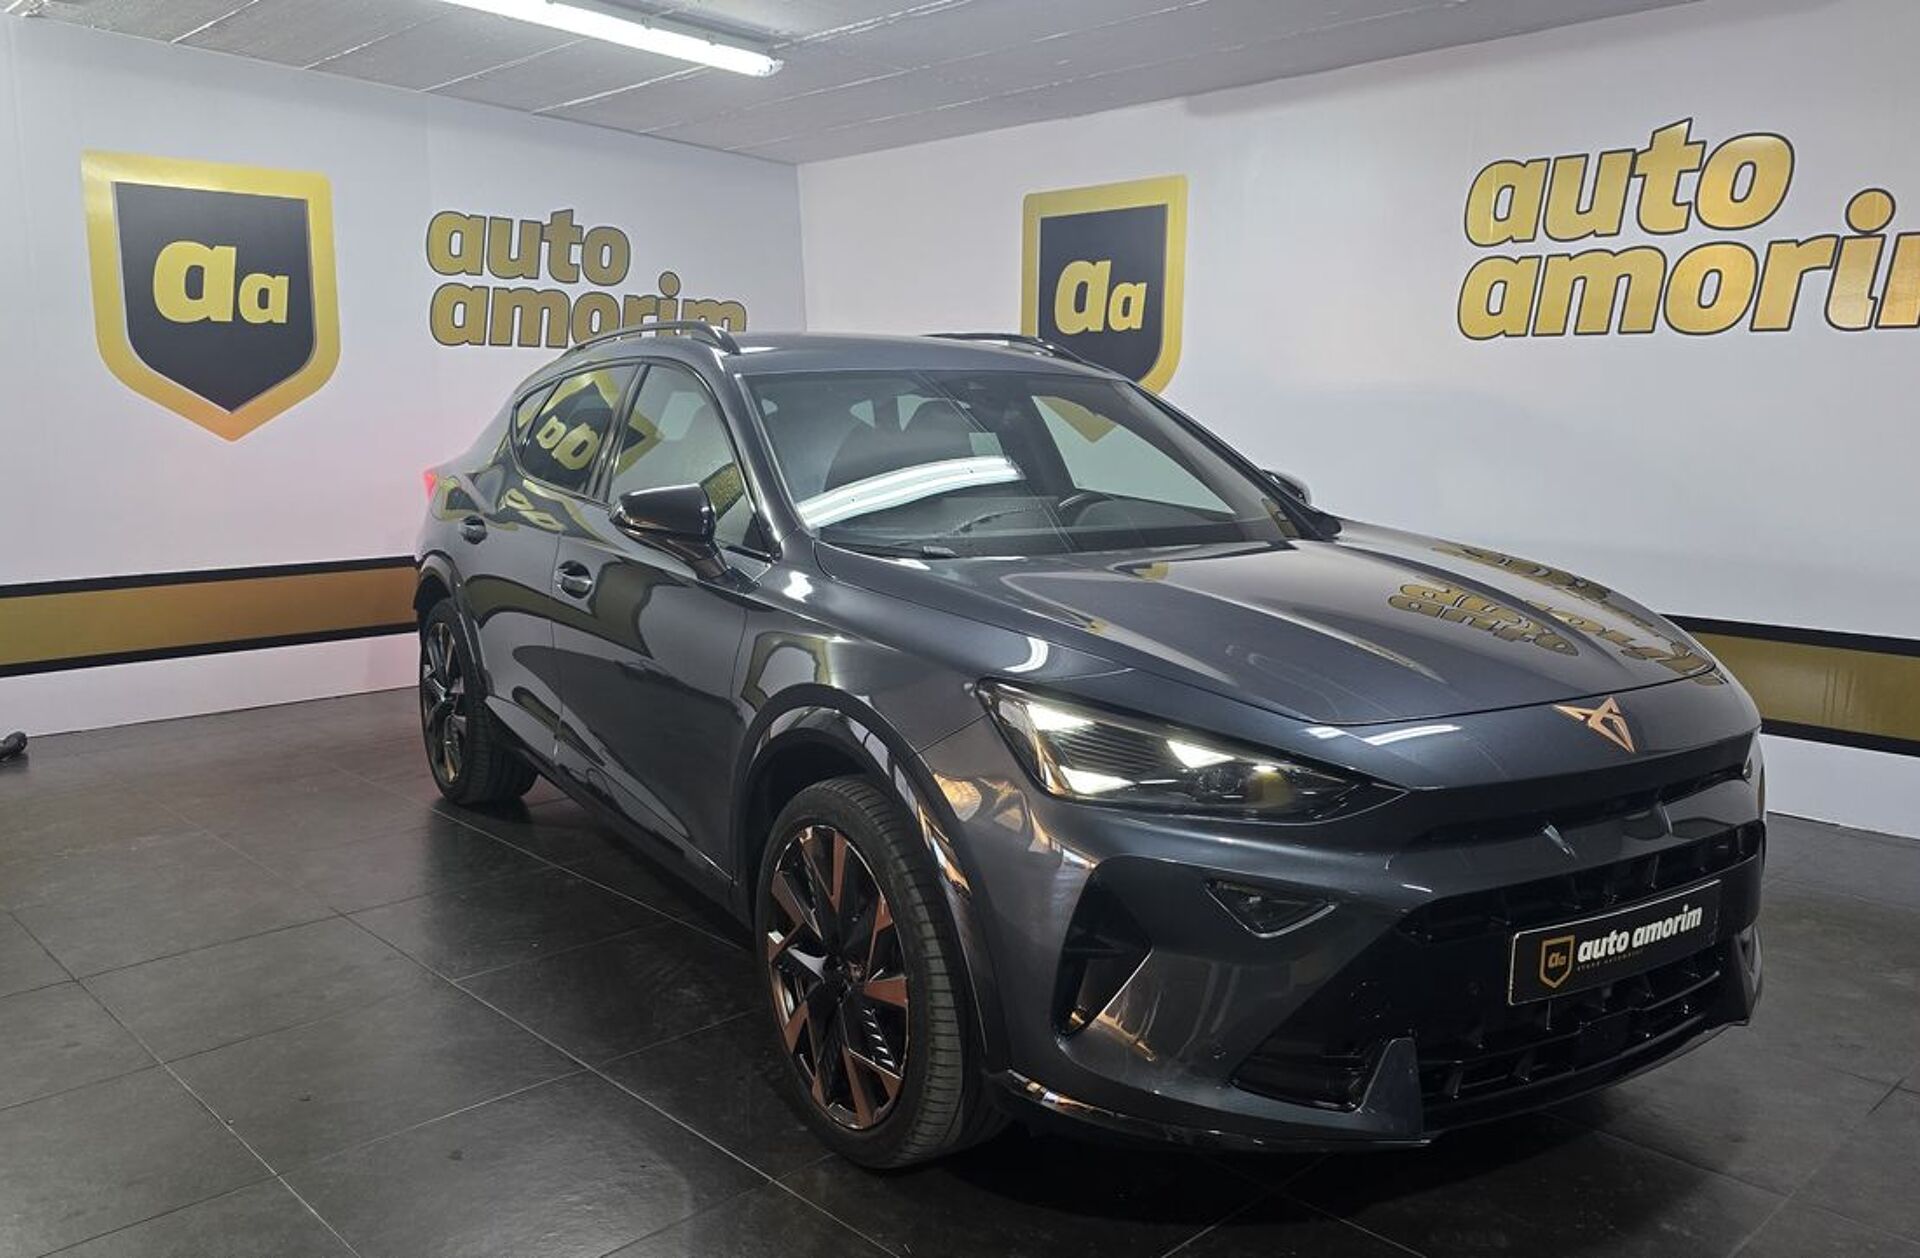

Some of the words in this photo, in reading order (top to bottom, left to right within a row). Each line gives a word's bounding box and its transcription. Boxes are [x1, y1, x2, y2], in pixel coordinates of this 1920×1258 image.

[1464, 117, 1796, 247] auto
[153, 240, 290, 324] aa
[426, 208, 631, 286] auto
[1457, 187, 1920, 341] amori
[1054, 260, 1148, 335] aa
[1577, 929, 1630, 963] auto
[1631, 903, 1703, 949] amorim
